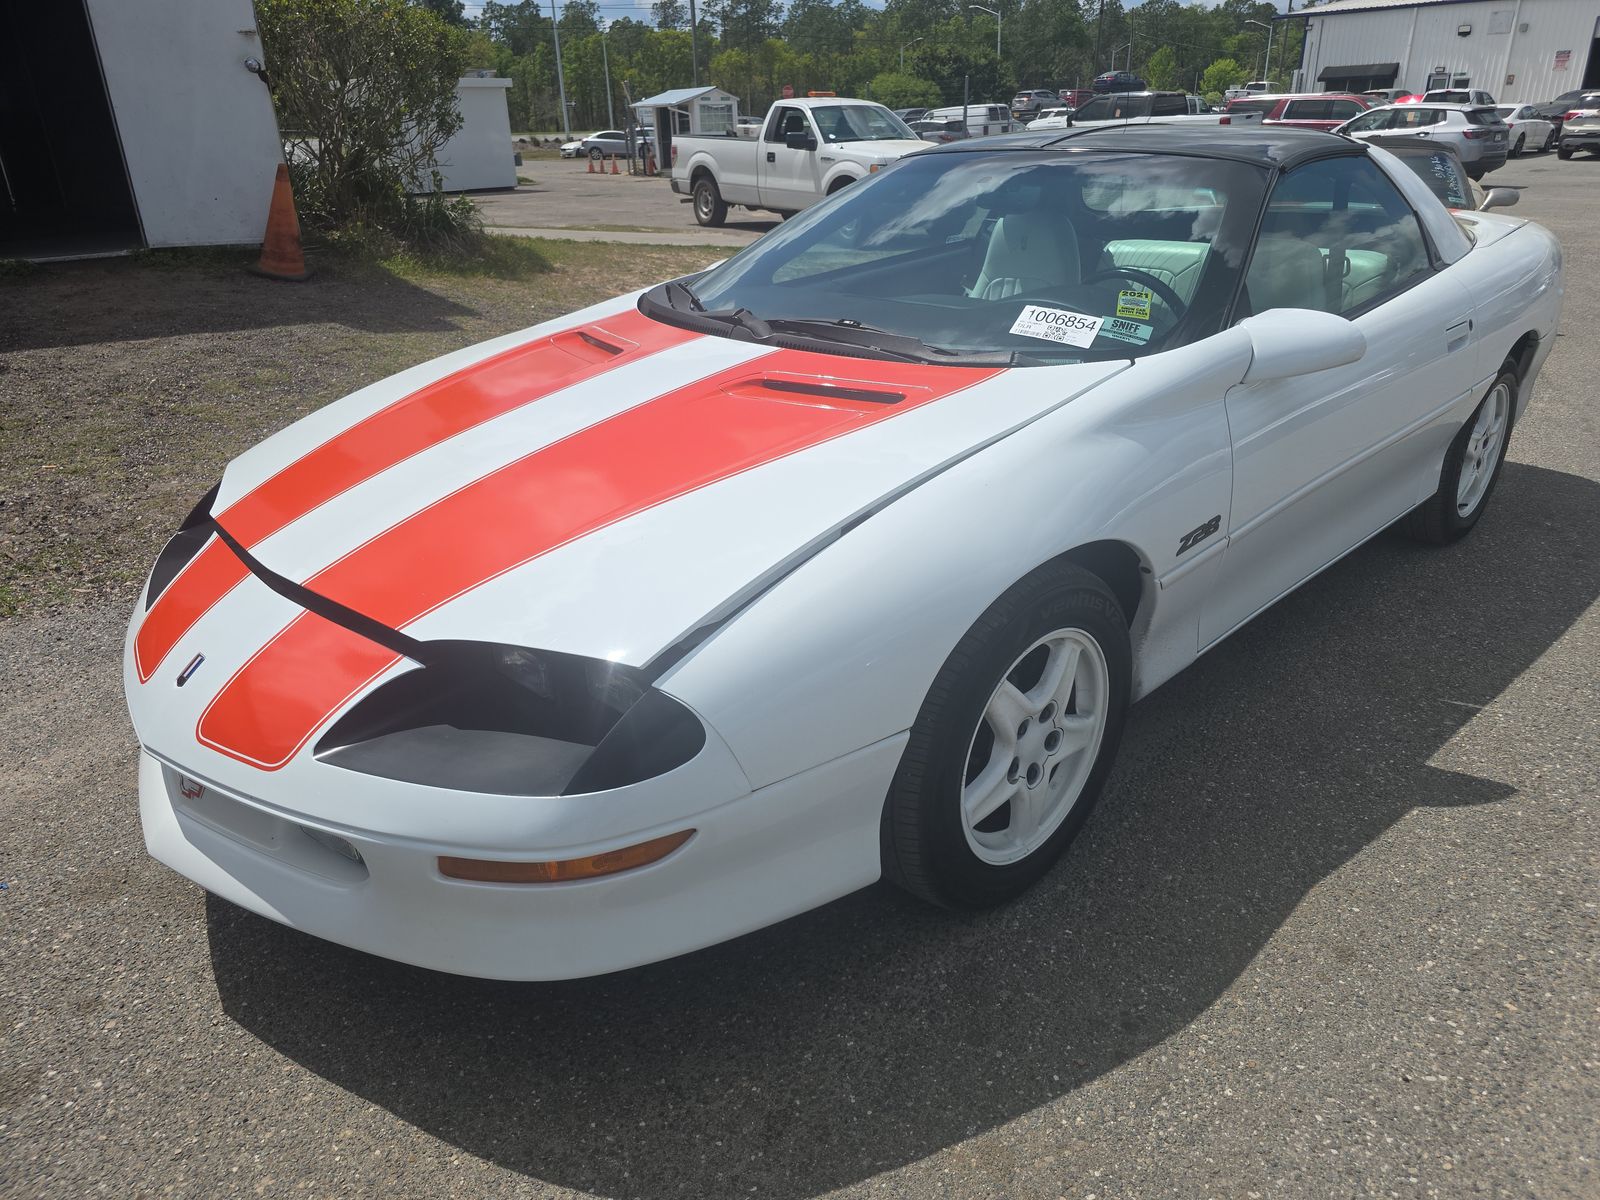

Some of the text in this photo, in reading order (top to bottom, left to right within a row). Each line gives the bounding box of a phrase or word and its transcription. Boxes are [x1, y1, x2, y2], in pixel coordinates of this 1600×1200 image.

[1121, 290, 1149, 299] 2021
[1028, 309, 1097, 332] 1006854
[1111, 319, 1141, 332] SNIFF
[1176, 514, 1222, 557] Z28
